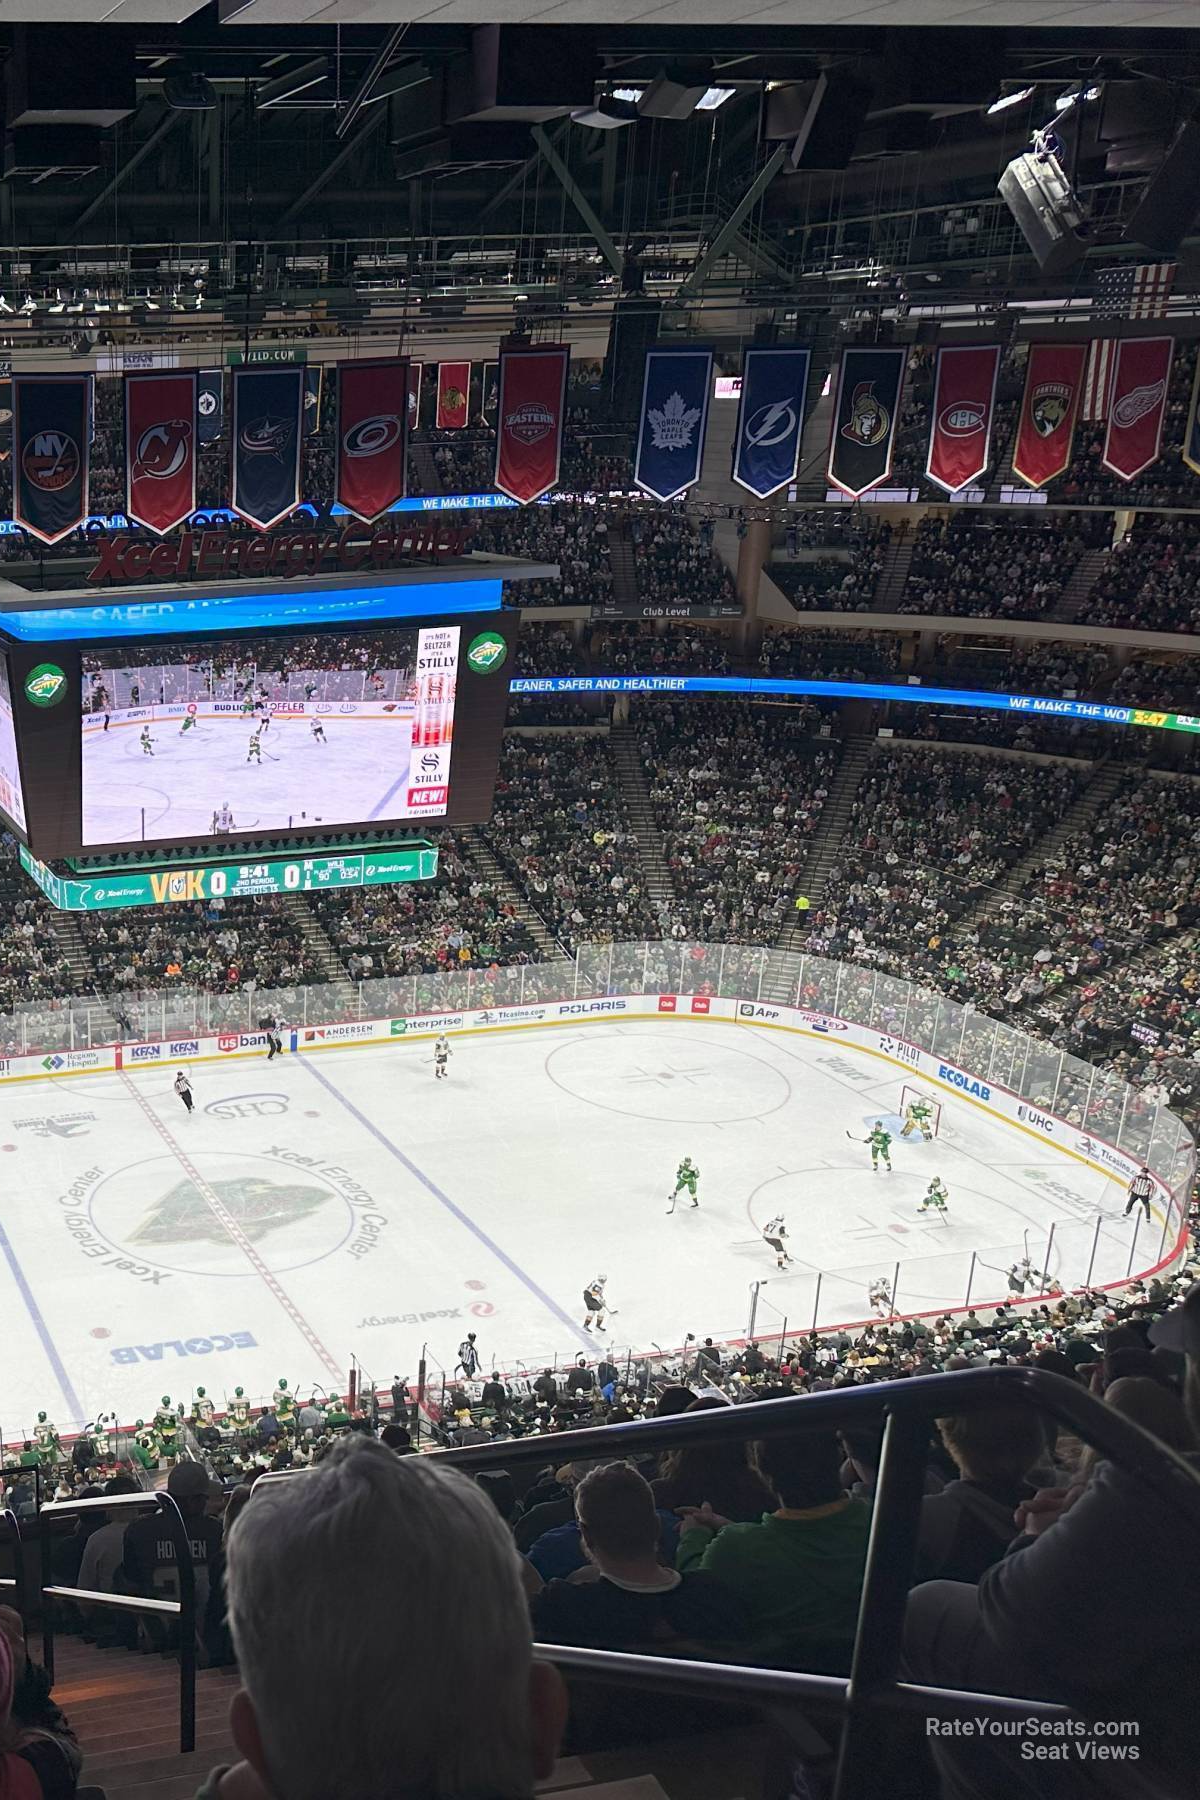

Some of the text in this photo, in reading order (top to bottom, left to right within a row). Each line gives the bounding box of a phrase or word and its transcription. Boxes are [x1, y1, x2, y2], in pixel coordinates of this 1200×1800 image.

[241, 350, 295, 362] WILD.COM
[508, 413, 553, 424] EASTERN
[657, 418, 690, 428] TORONTO
[34, 434, 67, 456] NY
[423, 496, 490, 508] WE MAKE THE
[87, 521, 477, 580] Xcel Energy Center
[642, 607, 690, 616] Club Level
[424, 640, 451, 650] SELTZER
[418, 656, 456, 669] STILLY
[510, 680, 555, 692] LEANER,
[558, 680, 592, 690] SAFER
[596, 680, 620, 689] AND
[1009, 698, 1100, 716] WE MAKE THE
[415, 774, 443, 784] STILLY
[412, 790, 444, 803] NEW!
[239, 865, 268, 879] 9:41
[284, 864, 300, 888] 0
[210, 871, 226, 895] 0
[251, 876, 274, 885] PERIOD
[242, 885, 268, 894] SHOTS
[560, 1001, 627, 1014] POLARIS
[326, 1024, 373, 1036] ANDERSEN
[220, 1034, 268, 1050] us ban
[67, 1052, 96, 1060] Regions
[898, 1042, 920, 1062] PILOT
[67, 1058, 99, 1068] Hospital
[938, 1064, 990, 1101] ECOLAB
[1028, 1111, 1054, 1132] UHC
[261, 1145, 388, 1260] Xcel Energy Center
[58, 1165, 174, 1285] Xcel Energy Center
[359, 1308, 462, 1328] Xcel Energy
[110, 1331, 258, 1365] ECOLAB
[234, 1408, 247, 1420] 10
[96, 1441, 108, 1454] 15
